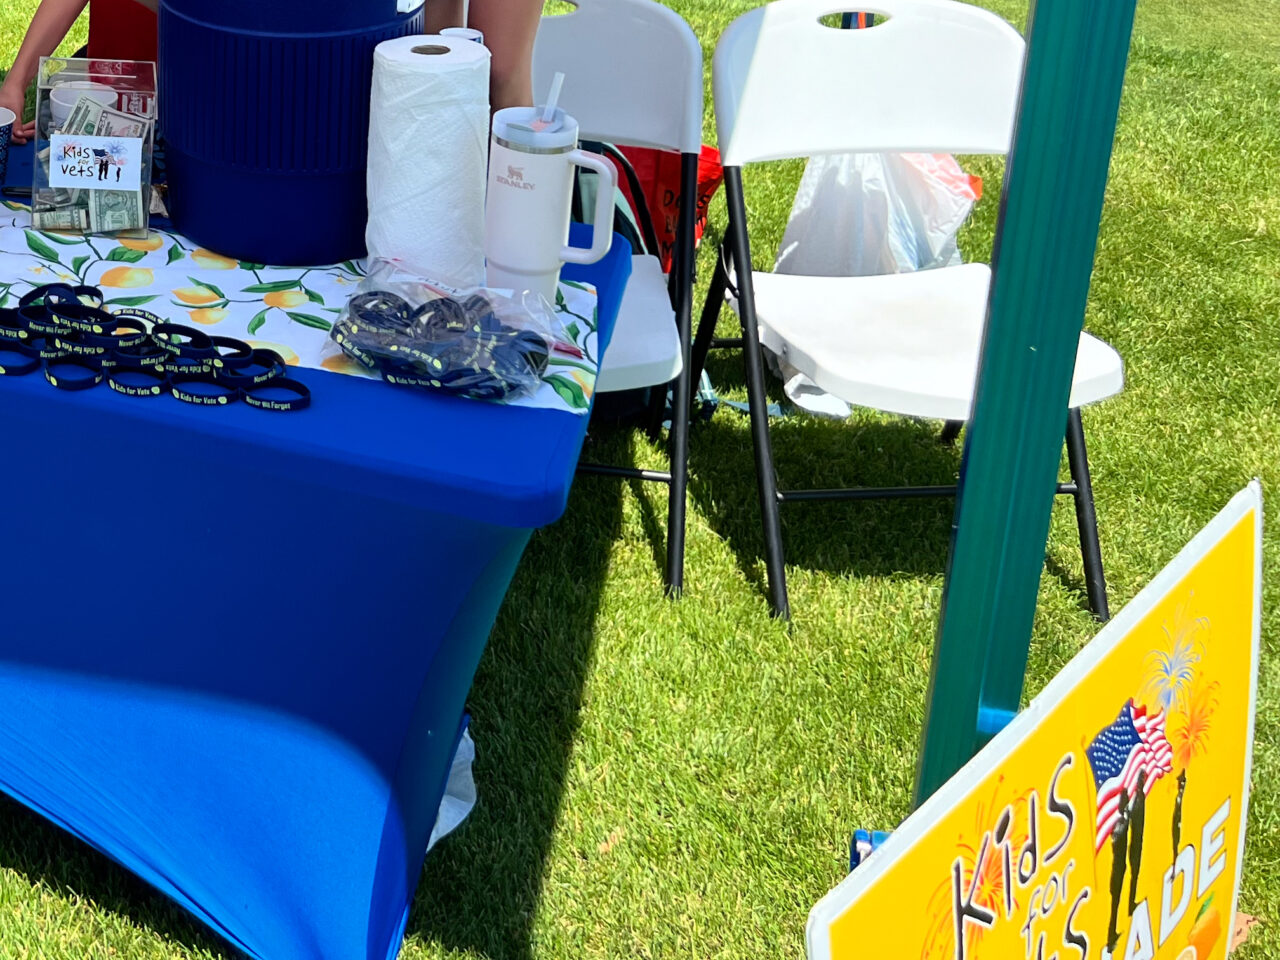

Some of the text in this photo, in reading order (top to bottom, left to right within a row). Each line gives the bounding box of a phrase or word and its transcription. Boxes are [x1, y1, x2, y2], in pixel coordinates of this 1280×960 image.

[63, 146, 90, 159] Kids
[77, 159, 90, 167] for
[952, 751, 1074, 960] Kids
[1101, 794, 1232, 960] ADE
[1022, 860, 1075, 959] for
